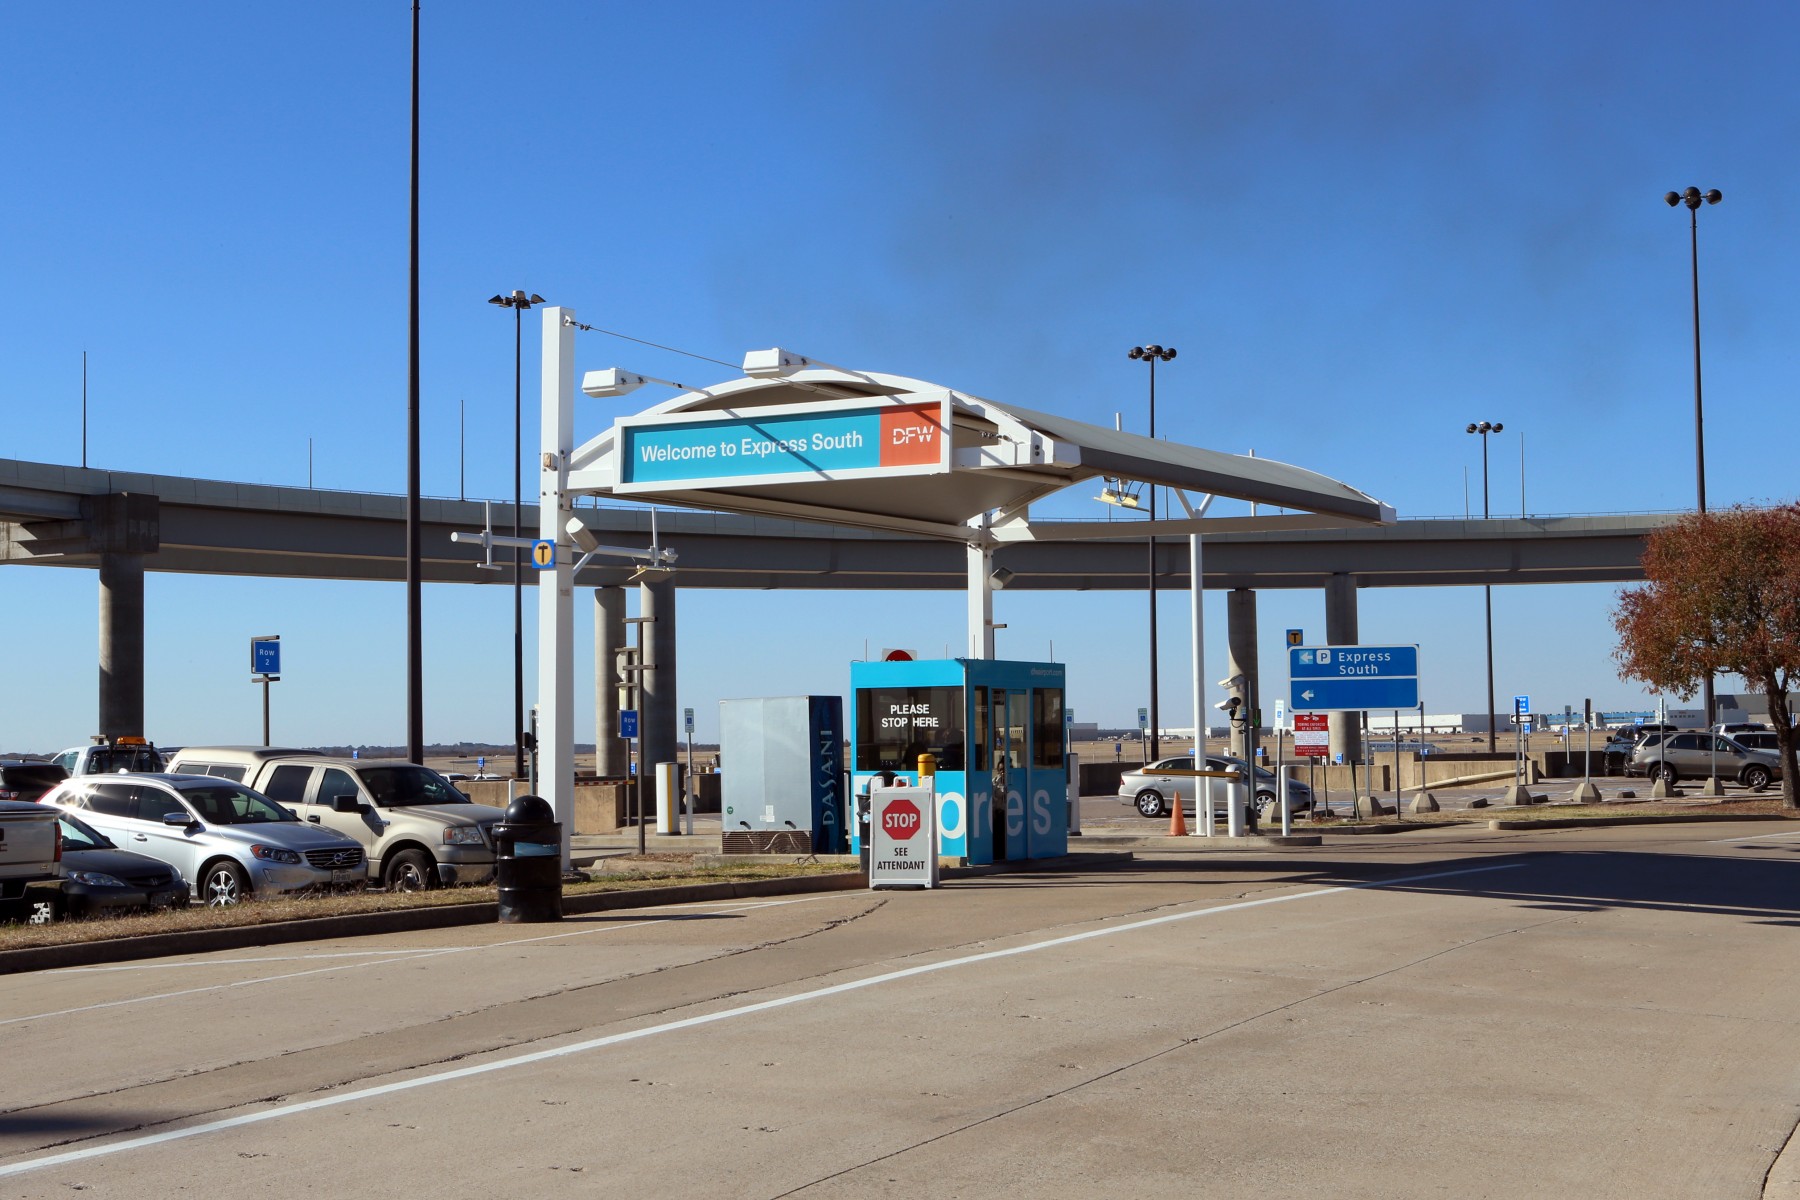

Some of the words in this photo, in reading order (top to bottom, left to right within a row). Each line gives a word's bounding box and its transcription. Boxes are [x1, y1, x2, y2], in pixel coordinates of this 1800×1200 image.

[893, 425, 934, 446] DFW
[641, 443, 717, 462] Welcome
[720, 442, 737, 457] to
[741, 437, 807, 458] Express
[812, 430, 863, 450] South
[259, 648, 275, 656] Row
[1320, 652, 1328, 662] P
[265, 658, 270, 666] 2
[1338, 652, 1391, 664] Express
[1339, 664, 1378, 675] South
[890, 704, 930, 715] PLEASE
[881, 717, 908, 728] STOP
[912, 717, 939, 728] HERE
[818, 730, 837, 826] DASANI
[885, 813, 918, 828] STOP
[894, 847, 908, 857] SEE
[877, 860, 925, 870] ATTENDANT
